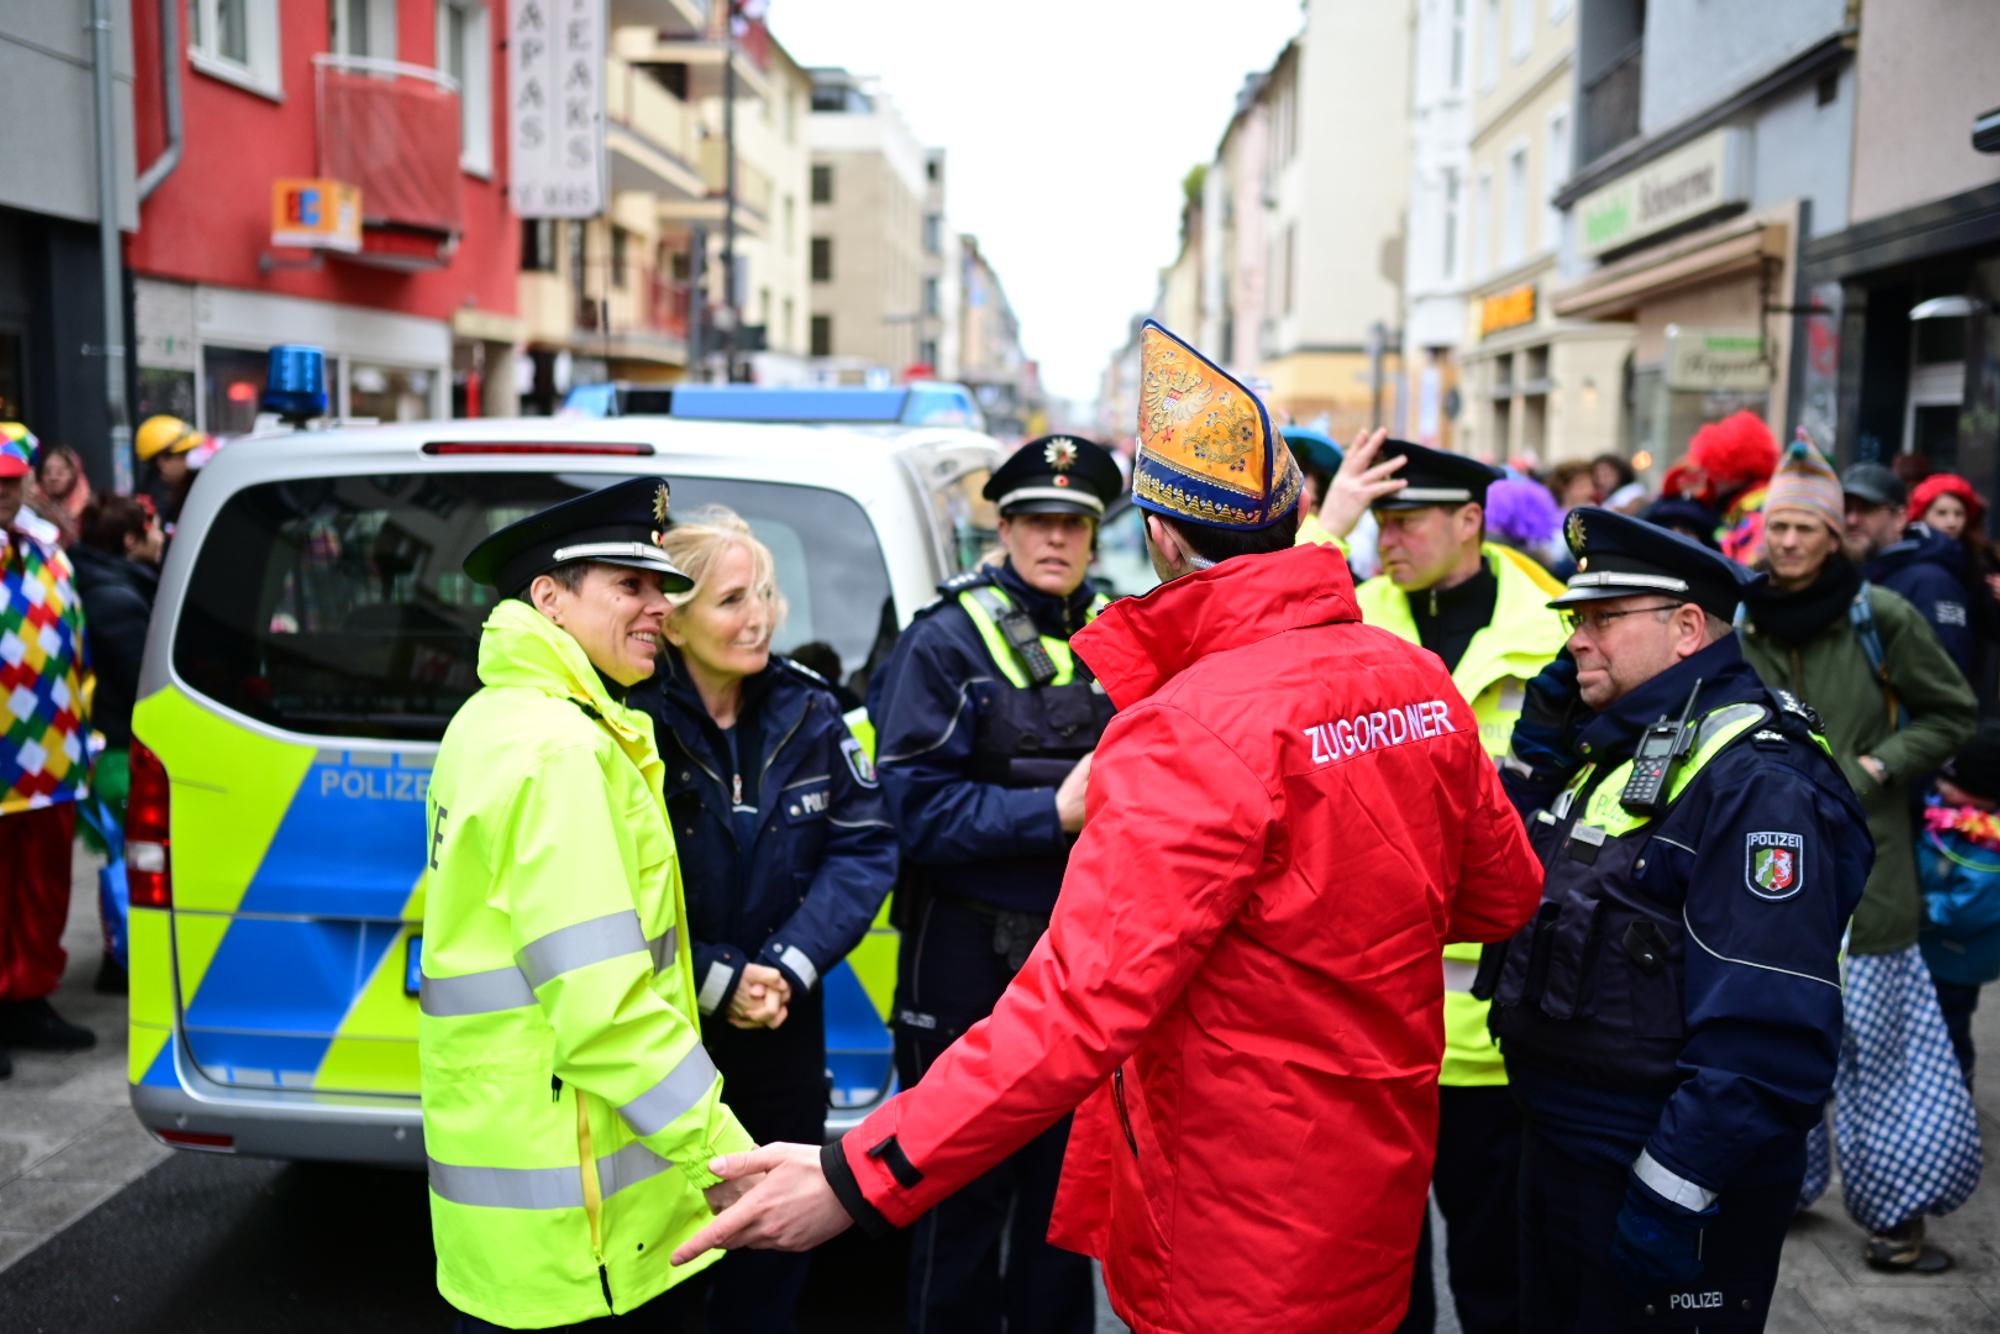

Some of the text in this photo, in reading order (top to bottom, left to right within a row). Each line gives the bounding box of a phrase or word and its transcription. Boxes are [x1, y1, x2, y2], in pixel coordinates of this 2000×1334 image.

[1303, 700, 1456, 764] ZUGORDNER
[320, 769, 429, 801] POLIZE
[1750, 834, 1799, 848] POLIZEI
[1670, 1291, 1723, 1310] POLIZEI
